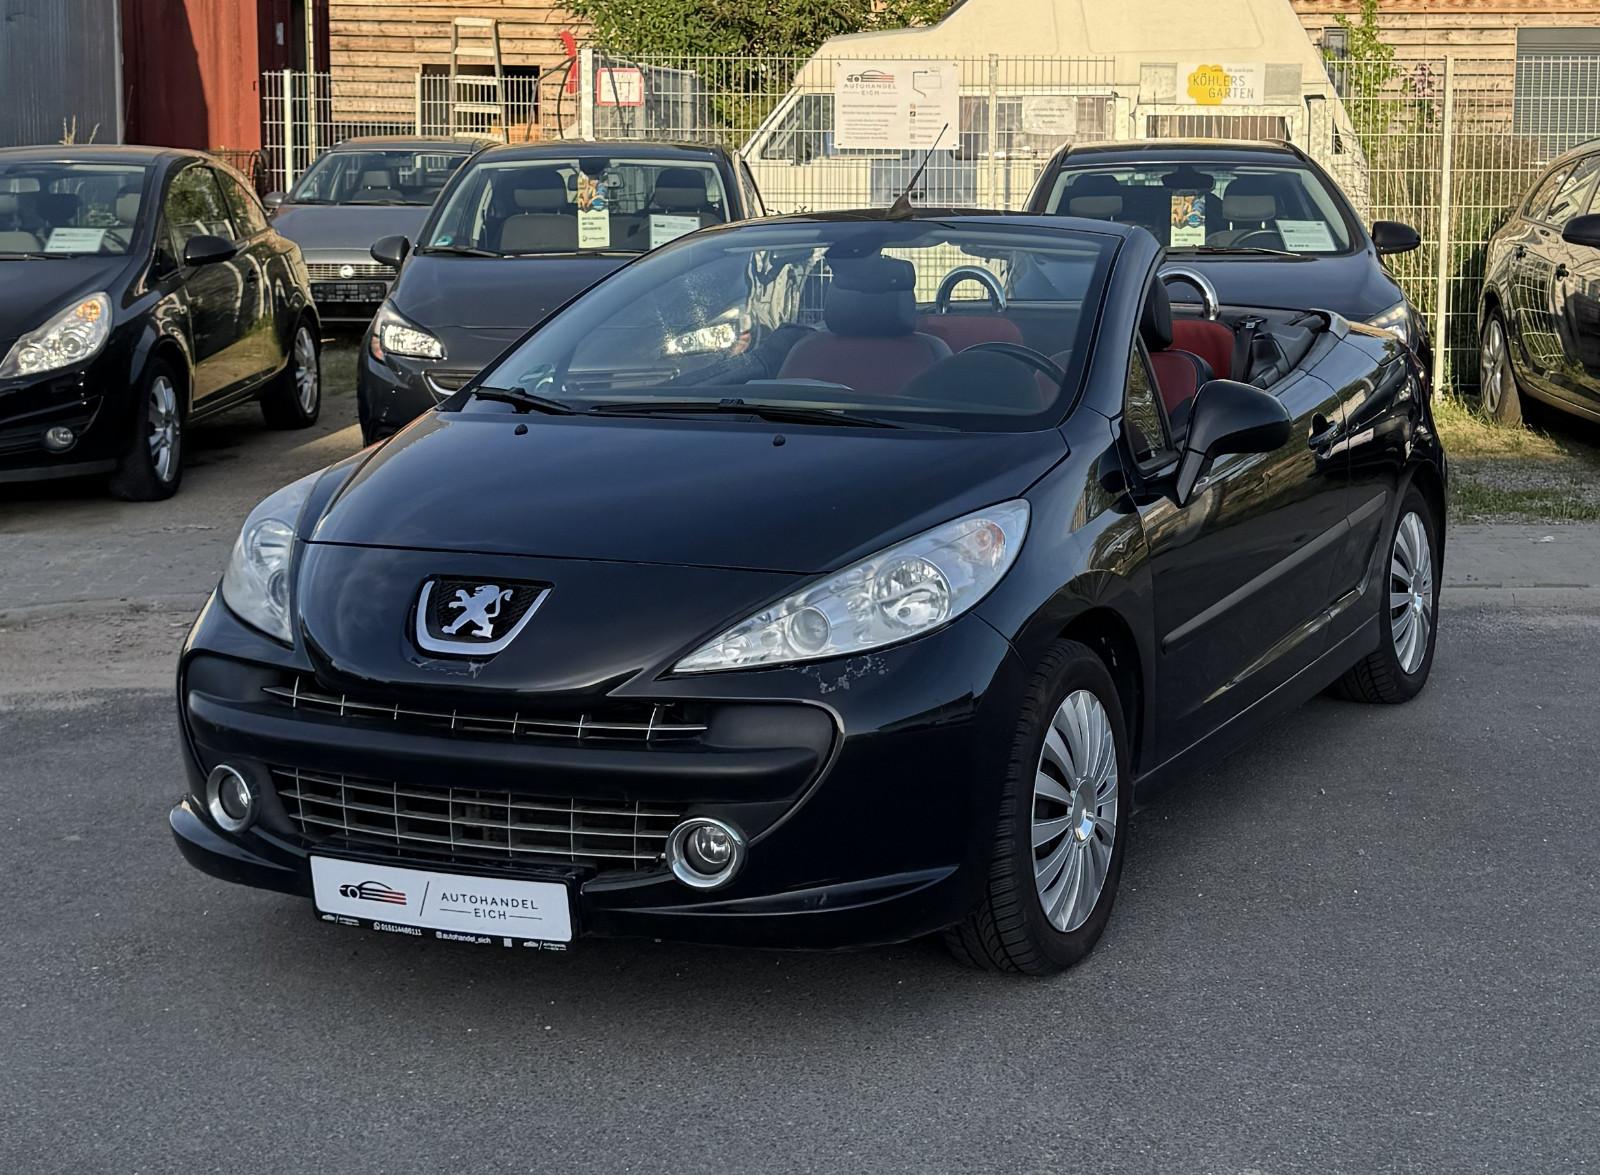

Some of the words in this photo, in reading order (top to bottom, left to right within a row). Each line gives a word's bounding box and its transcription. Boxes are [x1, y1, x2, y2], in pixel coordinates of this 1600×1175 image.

[1193, 73, 1246, 87] KÖHLERS
[1208, 87, 1254, 99] GARTEN
[441, 892, 539, 910] AUTOHANDEL
[474, 908, 507, 920] EICH
